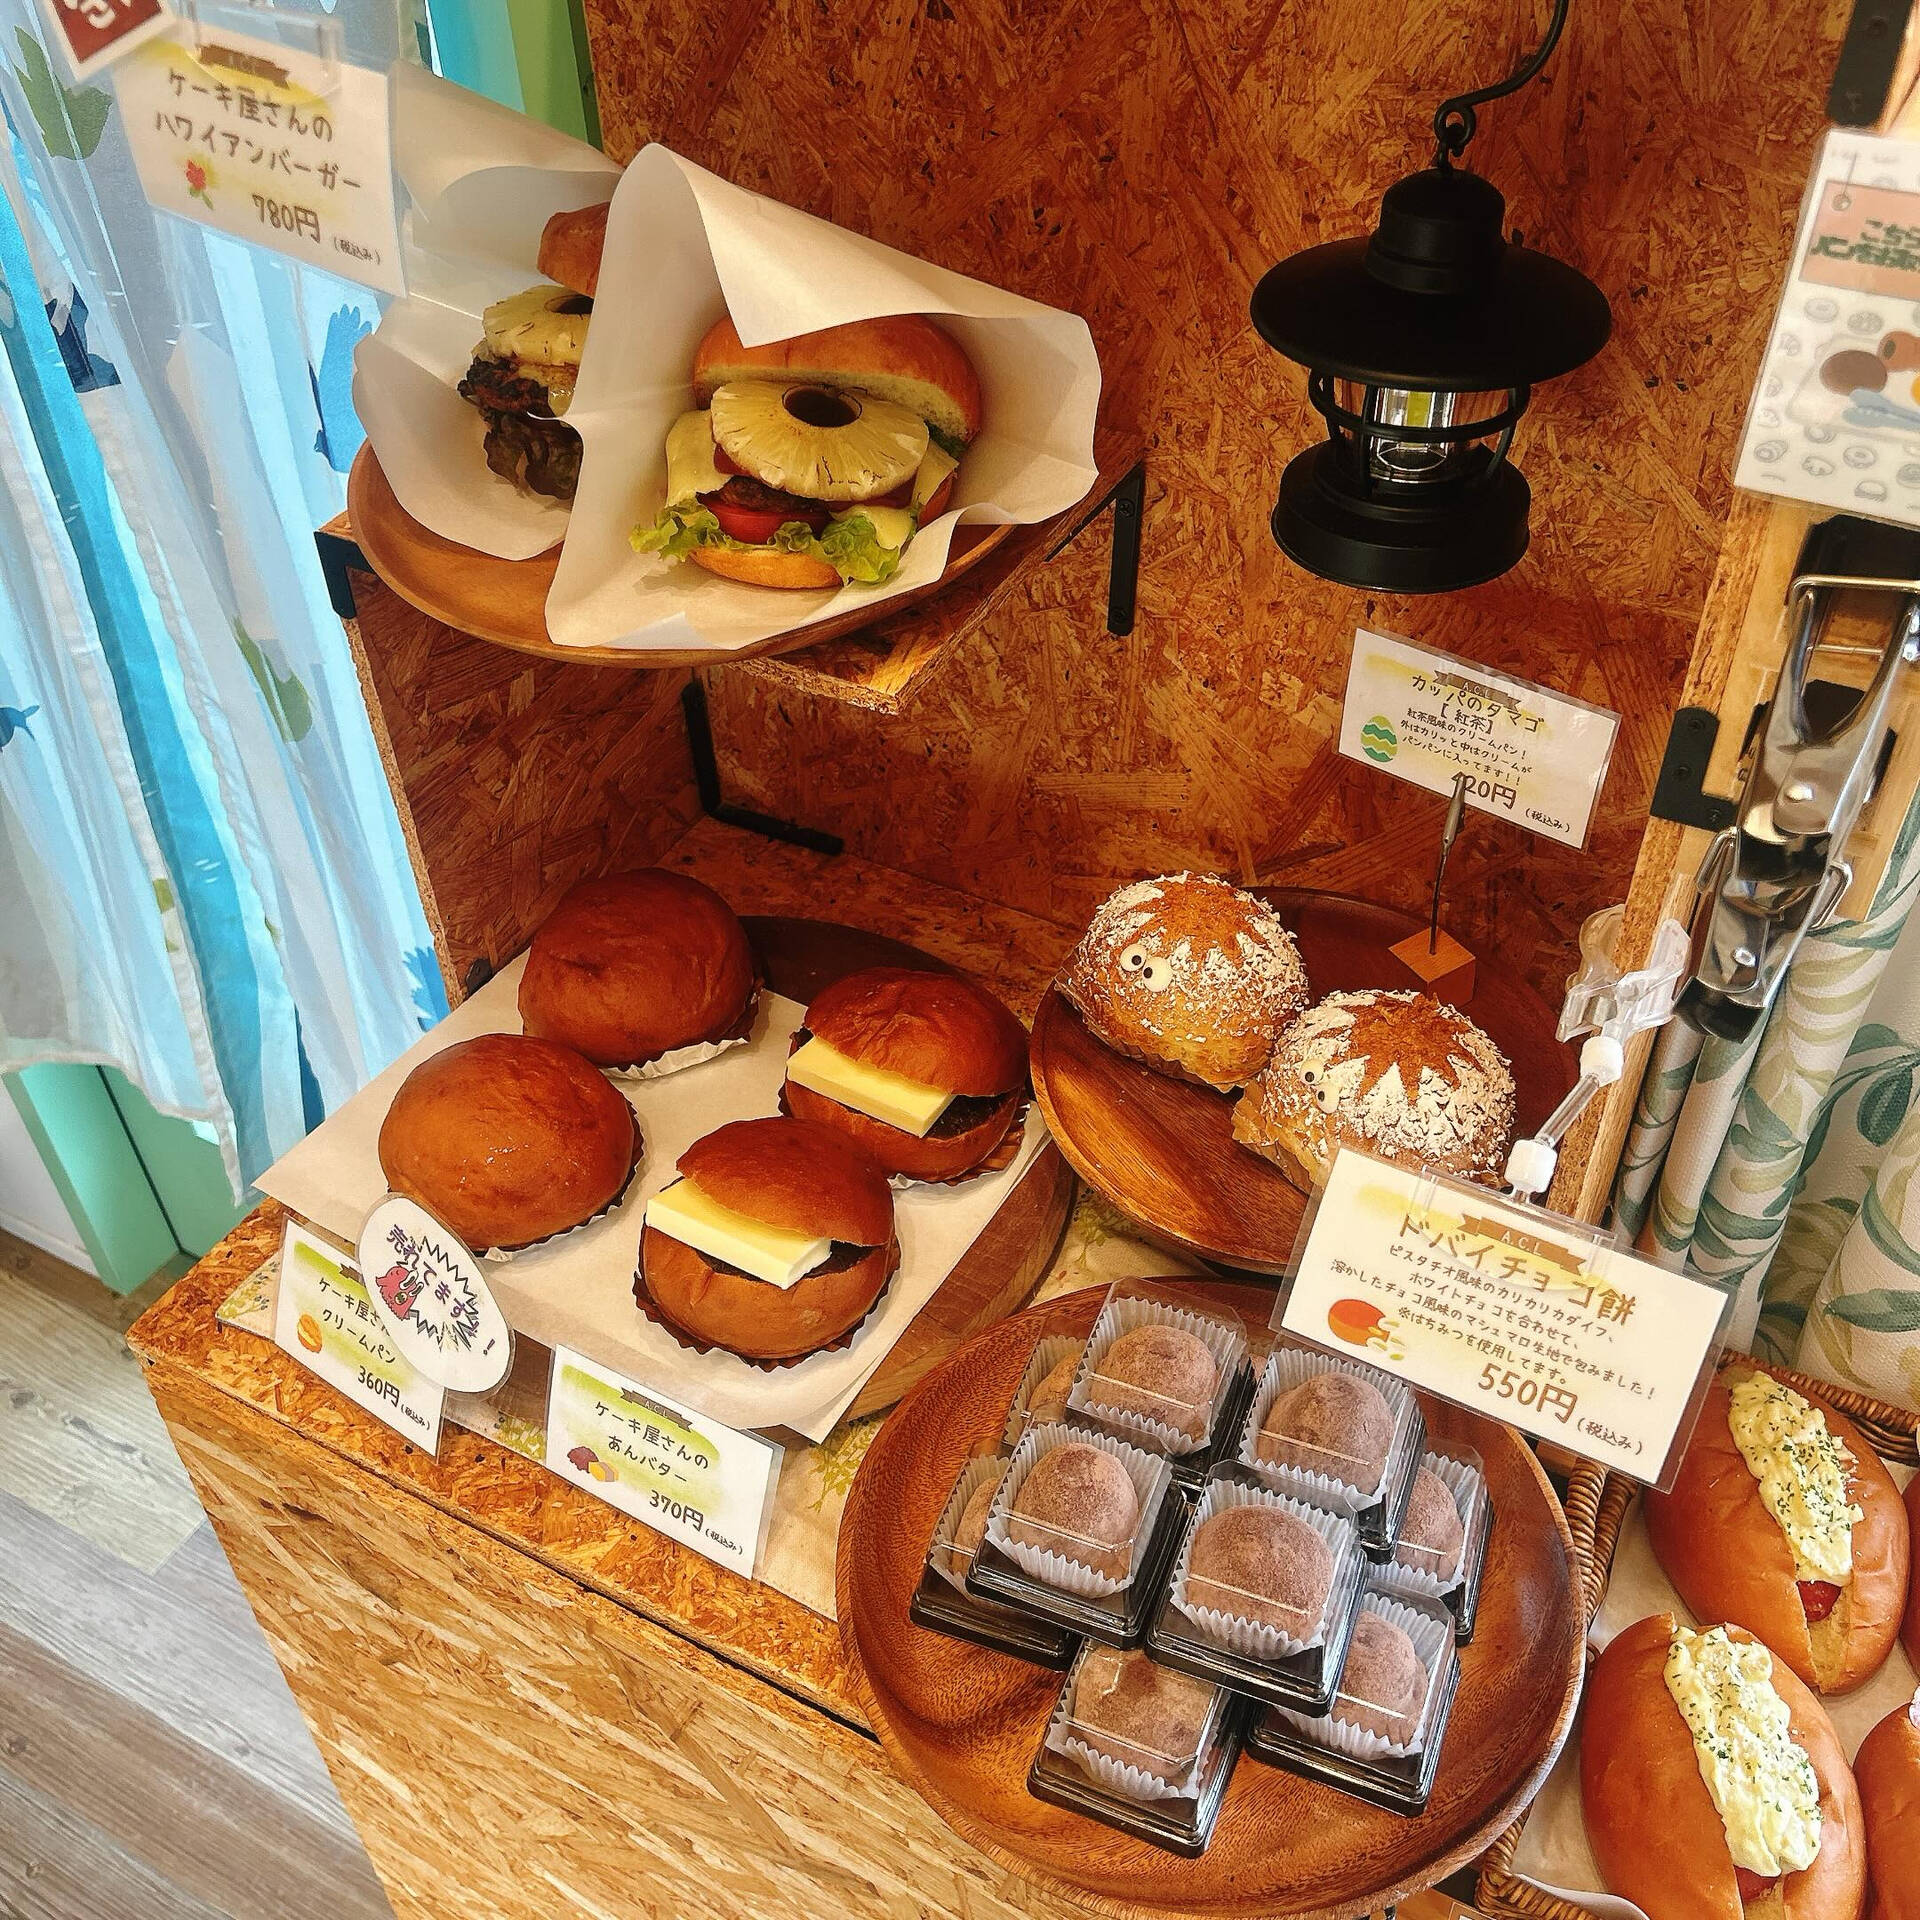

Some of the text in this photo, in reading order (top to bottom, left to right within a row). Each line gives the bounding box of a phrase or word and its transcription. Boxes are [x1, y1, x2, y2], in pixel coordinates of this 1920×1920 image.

[168, 67, 333, 143] ケーキ屋さんの
[155, 110, 362, 192] ハワイアンバーガー
[252, 193, 321, 244] 780円
[1411, 674, 1545, 733] カッパのタマゴ
[1440, 703, 1493, 735] 【紅茶】
[1400, 719, 1533, 775] 外はカリッと中はクリームが
[1402, 735, 1521, 787] パンパンに入ってます！！
[1406, 707, 1527, 761] 紅茶風味のクリームパン！
[1389, 1244, 1617, 1344] ピスタチオ風味のカリカリカダイフ、
[1399, 1213, 1636, 1328] ドバイチョコ餅
[322, 1308, 396, 1364] クリームパン
[1329, 1258, 1657, 1400] 溶かしたチョコ風味のマシュマロ生地で包みました！
[1408, 1271, 1580, 1350] ホワイトチョコを合わせて、
[1398, 1306, 1568, 1386] ※はちみつを使用してます。
[357, 1365, 400, 1408] 360円
[1477, 1362, 1579, 1425] 550円
[594, 1401, 709, 1470] ケーキ屋さんの
[607, 1435, 687, 1483] あんバター
[649, 1489, 704, 1532] 370円
